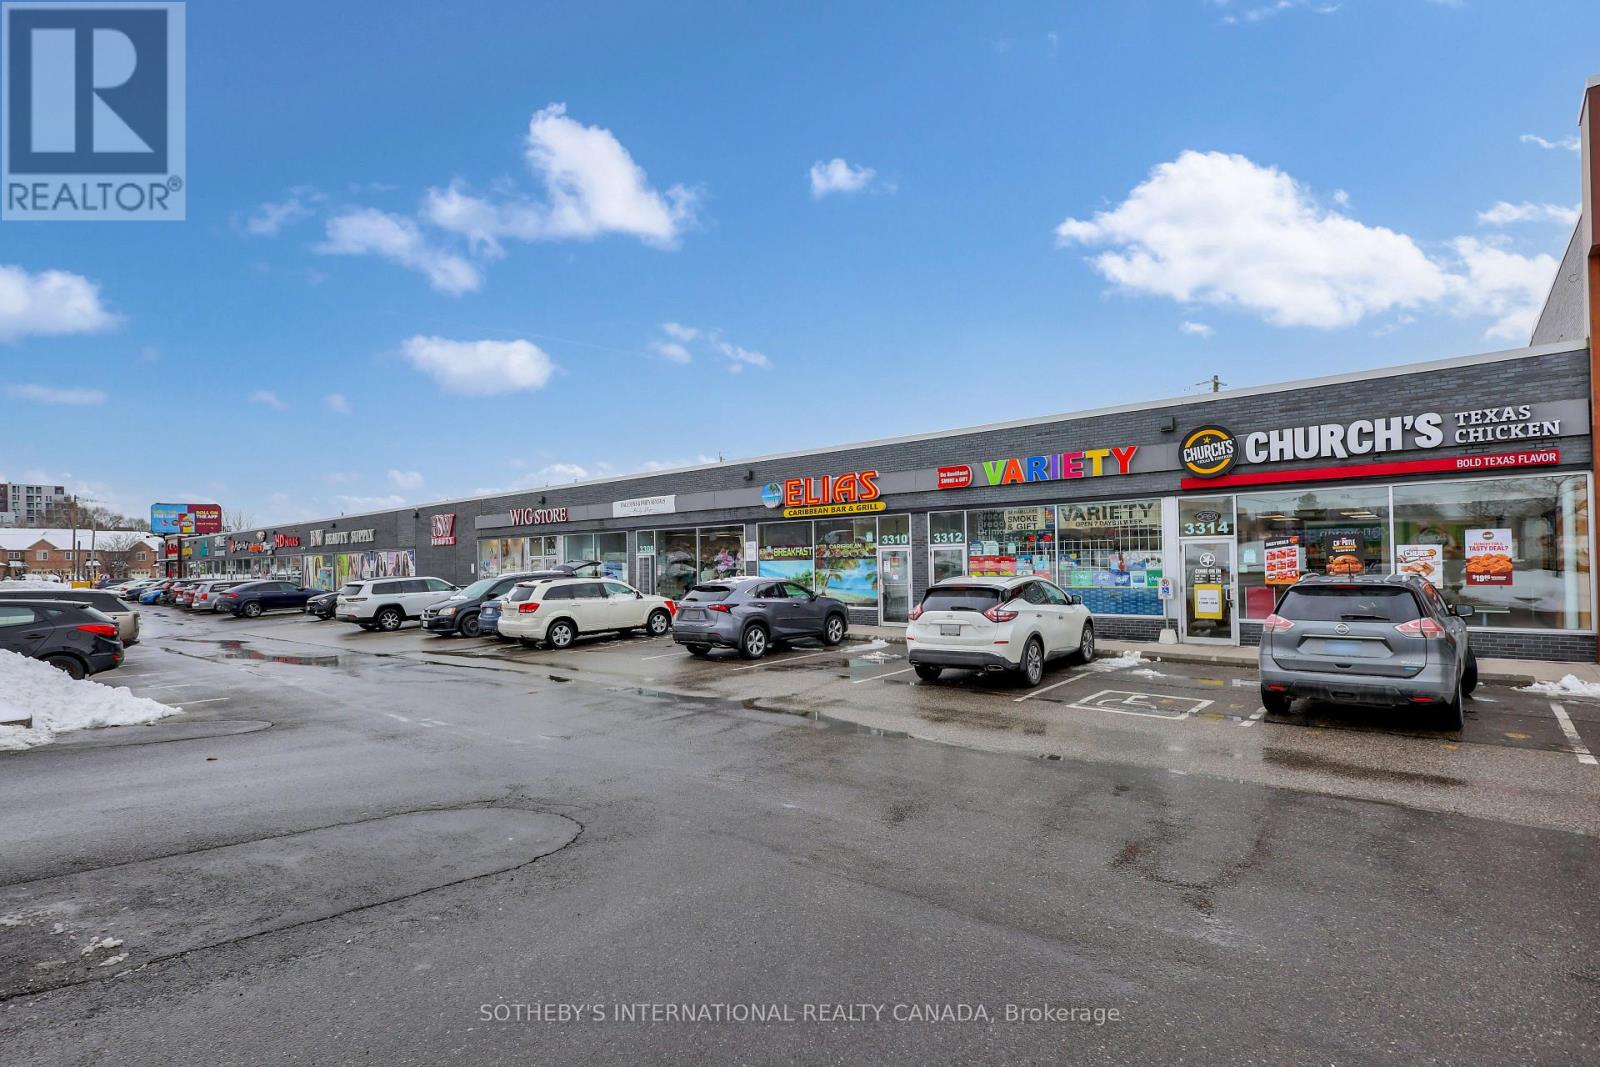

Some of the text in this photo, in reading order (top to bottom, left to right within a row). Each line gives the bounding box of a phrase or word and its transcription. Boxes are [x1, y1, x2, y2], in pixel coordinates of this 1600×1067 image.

[1454, 405, 1531, 426] TEXAS
[1245, 412, 1444, 463] CHURCH'S
[1454, 420, 1560, 444] CHICKEN
[1183, 440, 1234, 462] CHURCH'S
[982, 445, 1138, 486] VARIETY
[1456, 453, 1556, 468] BOLD TEXAS FLAVOR
[785, 470, 880, 507] ELIAS
[509, 507, 567, 525] WIG STORE
[789, 507, 829, 516] CARIBBEAN
[1061, 503, 1153, 521] VARIETY
[326, 532, 349, 545] BEAUTY
[350, 529, 376, 543] SUPPLY
[1184, 522, 1229, 534] 3314
[882, 534, 908, 544] 3310
[933, 532, 963, 543] 3312
[774, 547, 813, 557] BREAKFAST
